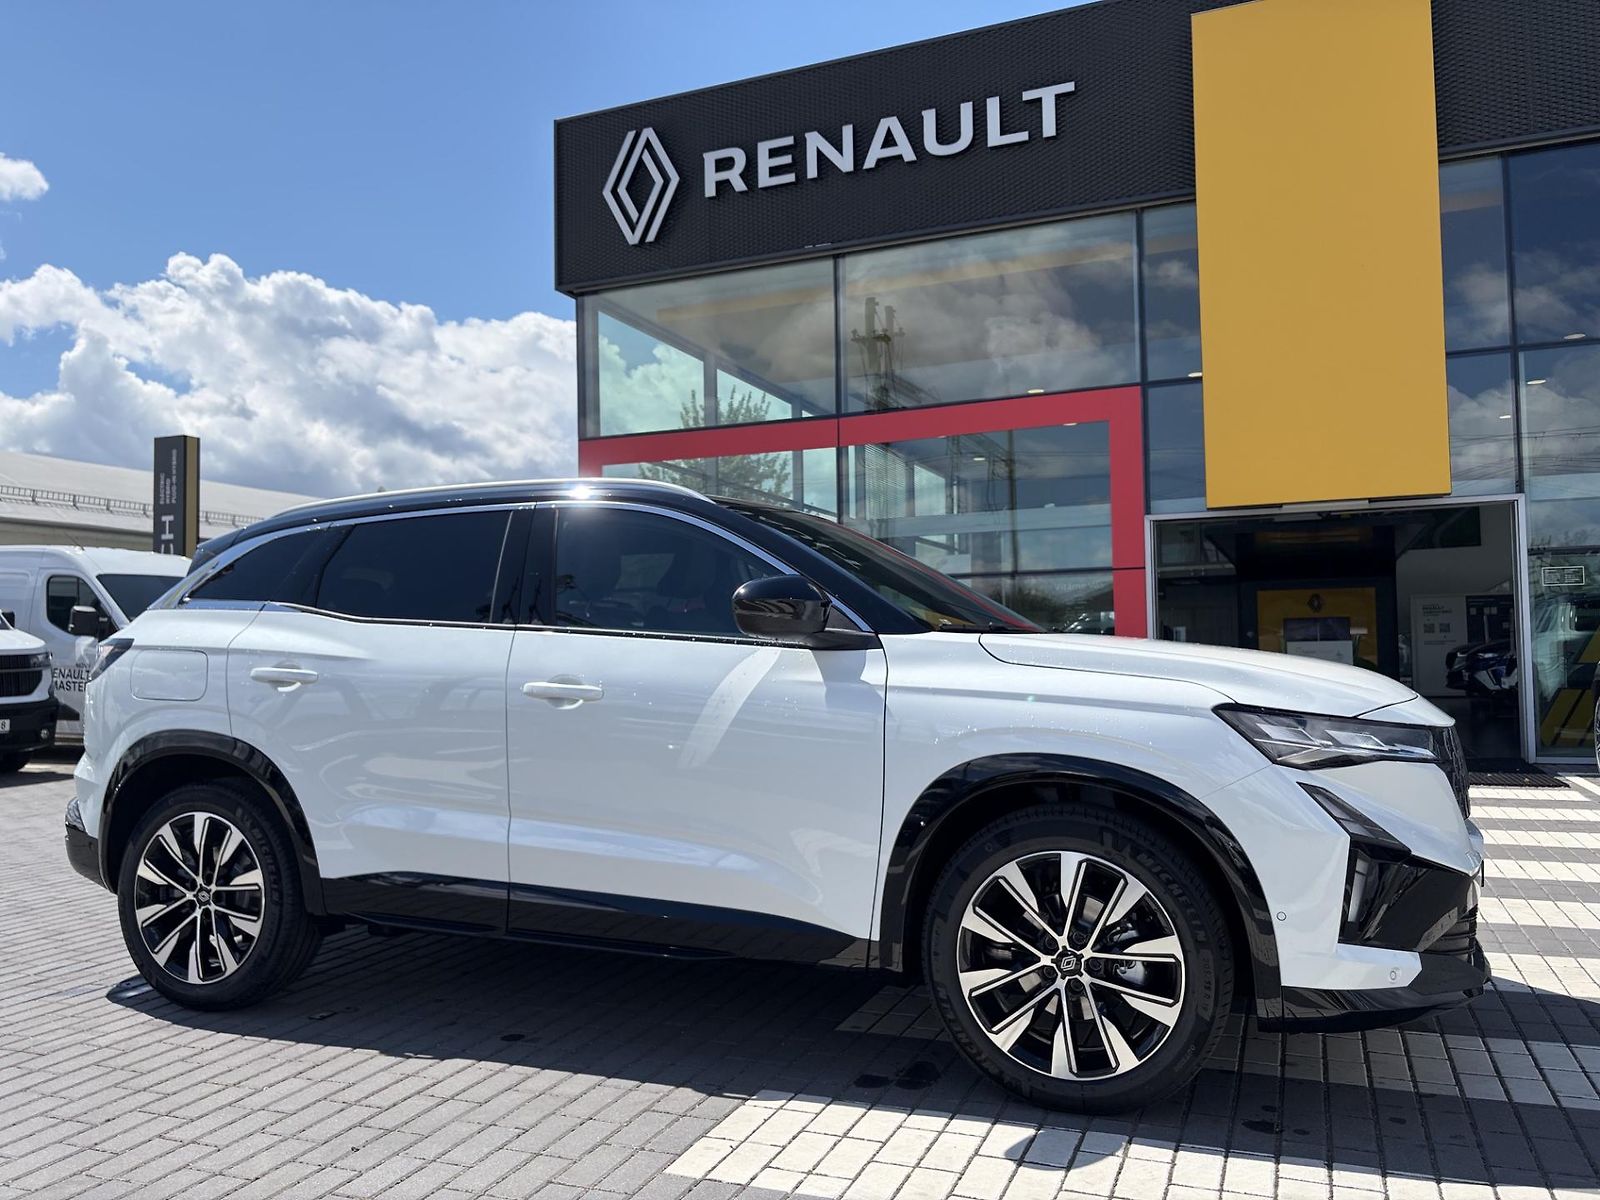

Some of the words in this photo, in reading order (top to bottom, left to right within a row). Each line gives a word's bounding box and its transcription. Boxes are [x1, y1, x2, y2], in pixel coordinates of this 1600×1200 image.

[703, 81, 1077, 199] RENAULT
[52, 668, 90, 681] ENAULT
[1135, 852, 1208, 943] MICHELIN
